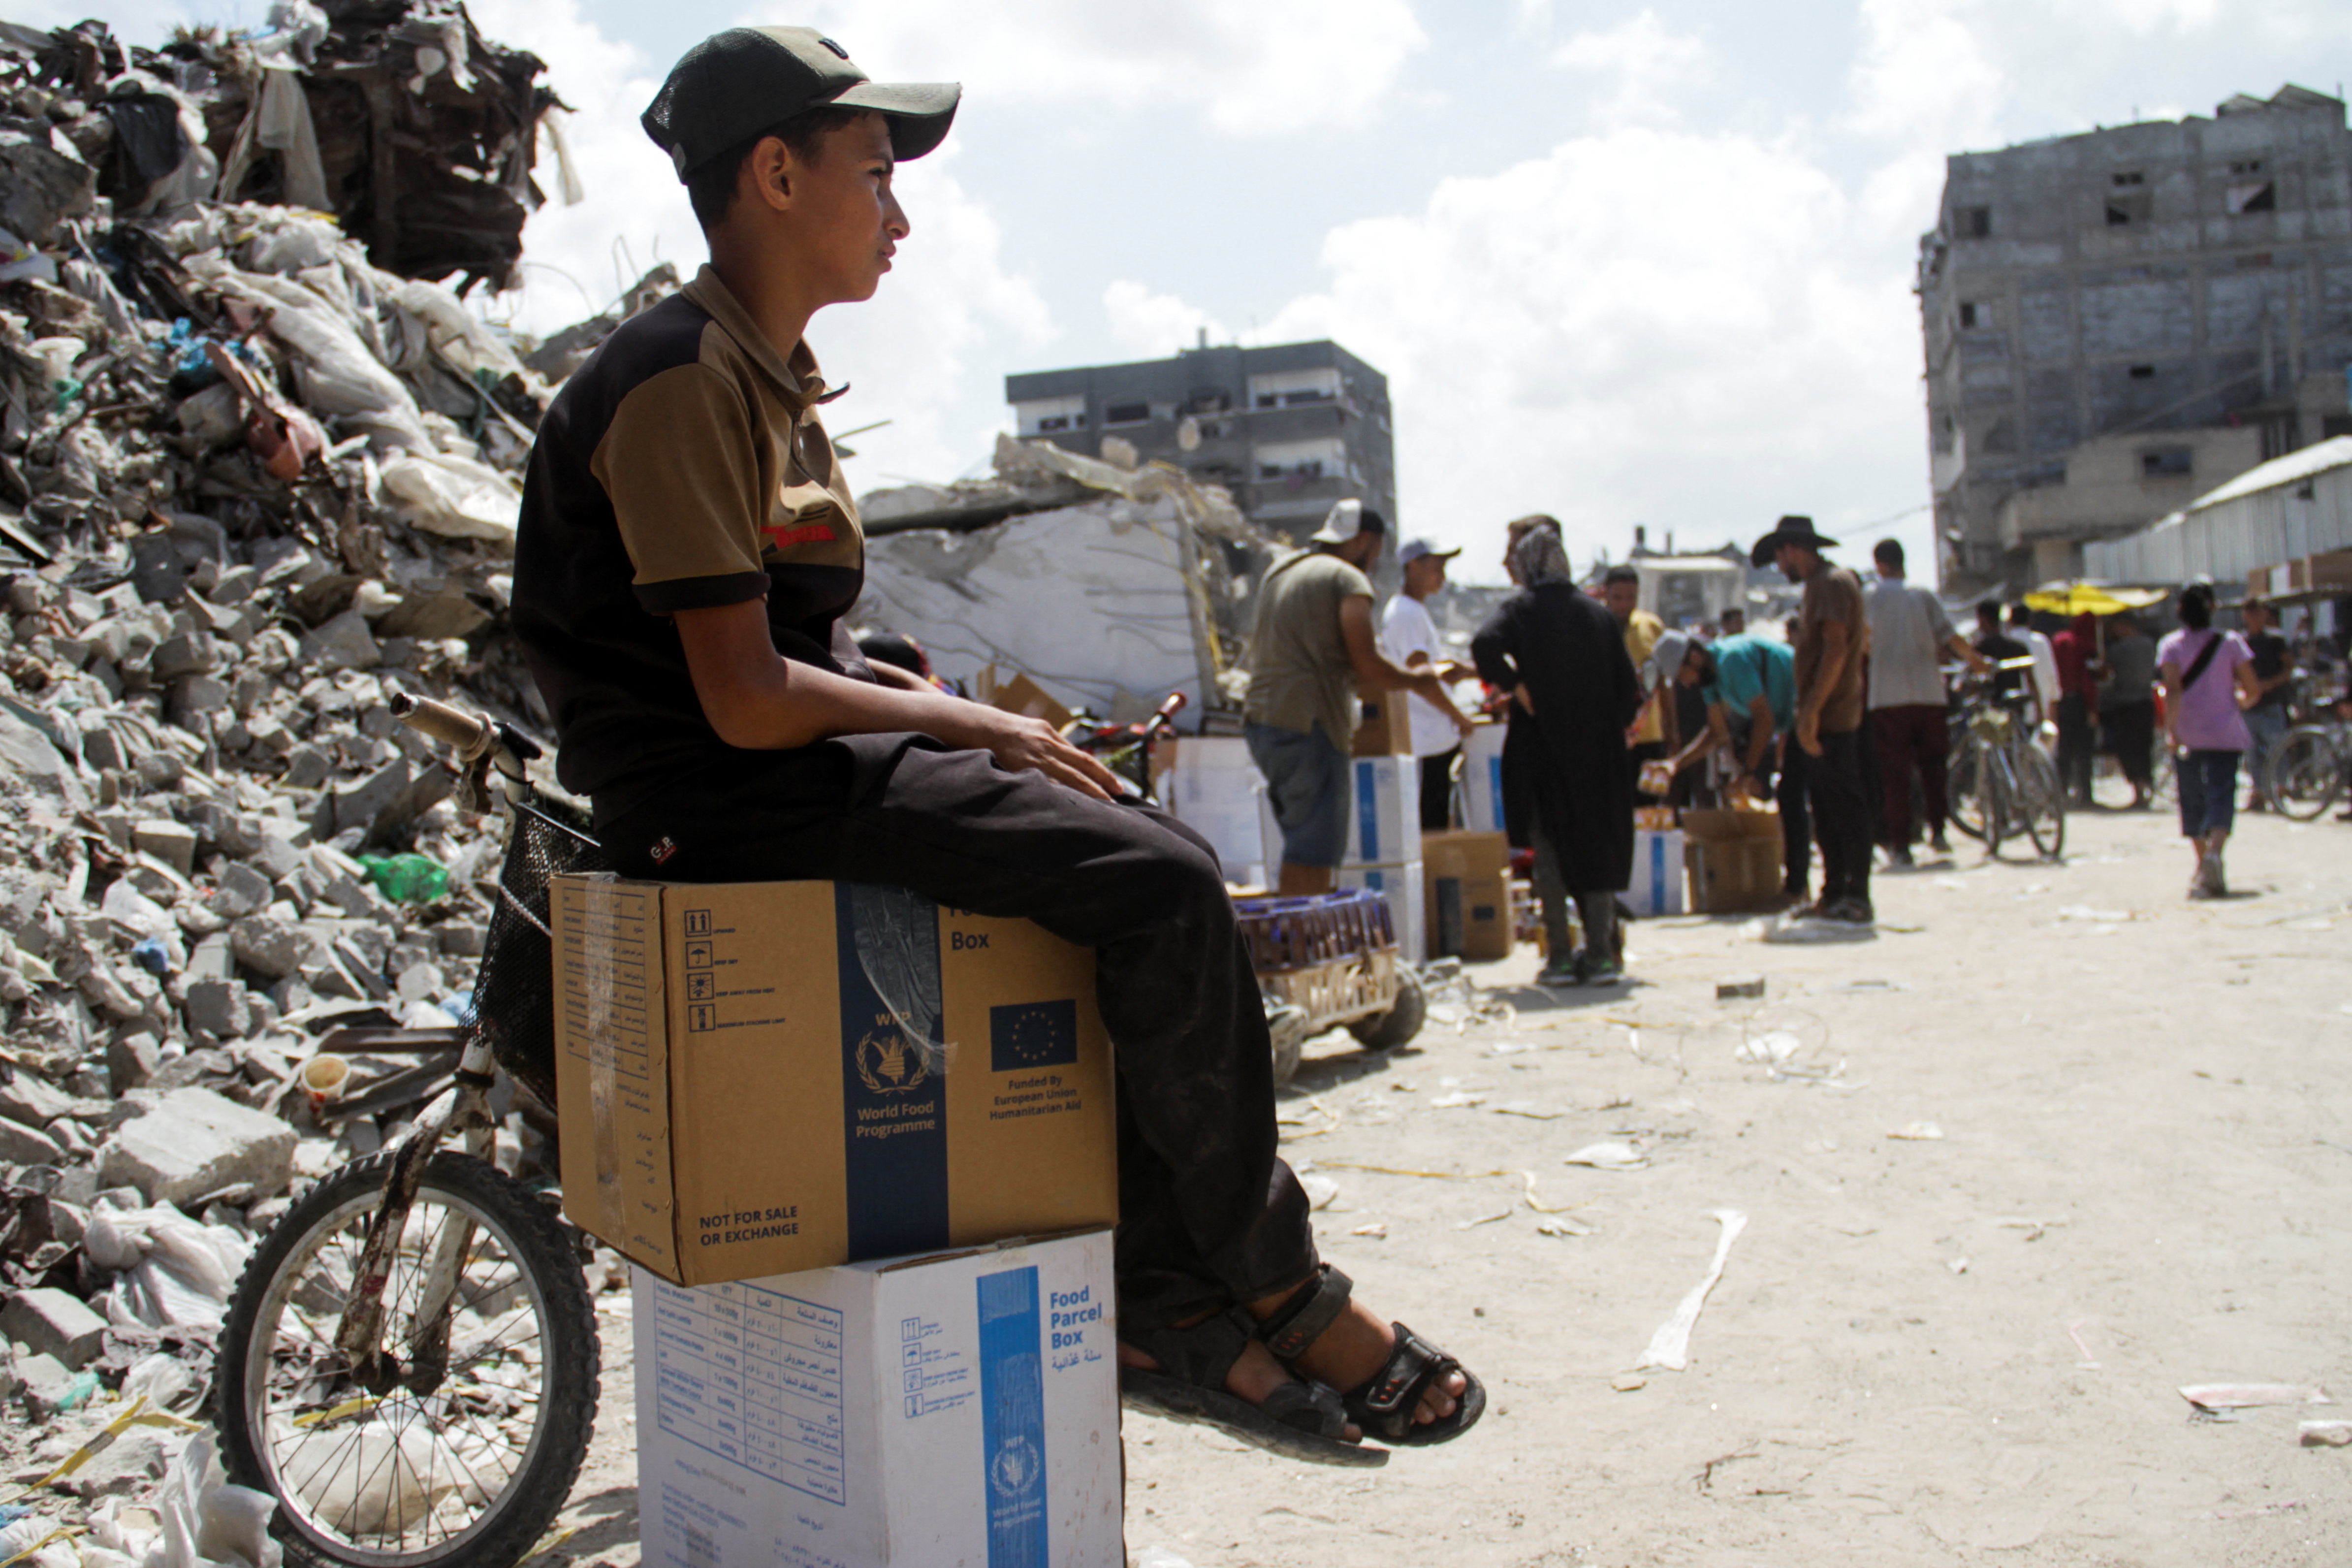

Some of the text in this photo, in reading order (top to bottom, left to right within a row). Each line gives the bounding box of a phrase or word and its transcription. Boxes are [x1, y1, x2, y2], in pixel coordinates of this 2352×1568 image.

[952, 931, 989, 951] Box
[1009, 1075, 1062, 1090] Funded By
[994, 1088, 1077, 1106] European Union
[857, 1100, 934, 1120] World Food
[990, 1099, 1081, 1120] Humanitarian Aid
[856, 1120, 935, 1139] Programme
[700, 1206, 797, 1229] NOT FOR SALE
[700, 1223, 798, 1246] OR EXCHANGE
[1050, 1285, 1089, 1309] Food
[1051, 1302, 1102, 1329] Parcel
[1051, 1331, 1082, 1349] Box
[1052, 1349, 1102, 1372] سلة غذائية
[1005, 1435, 1024, 1449] WFP
[993, 1497, 1040, 1519] World Food
[993, 1510, 1041, 1529] Programme
